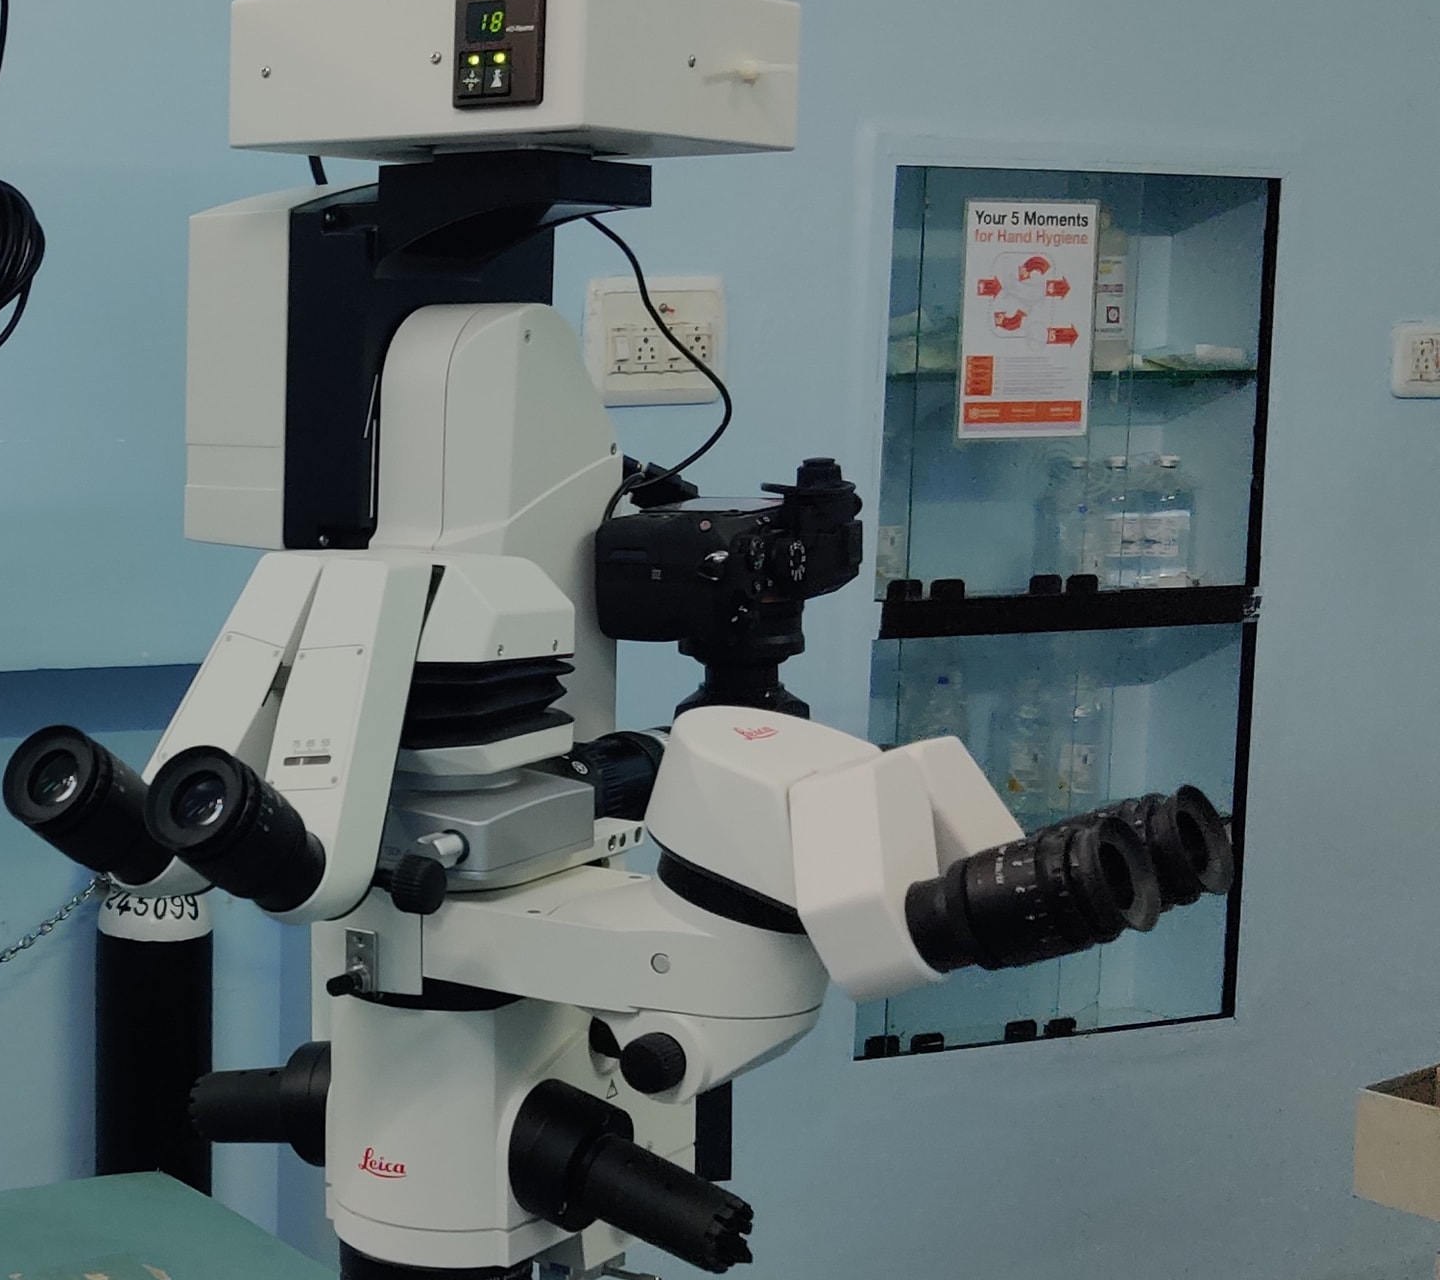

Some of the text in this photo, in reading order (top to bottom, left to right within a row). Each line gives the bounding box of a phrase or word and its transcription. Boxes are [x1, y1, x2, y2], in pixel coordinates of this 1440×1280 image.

[480, 11, 505, 33] 18
[975, 209, 1089, 228] Your 5 Moments
[975, 228, 1089, 246] for Hand Hygiene
[733, 725, 779, 741] Leica
[358, 1147, 407, 1180] Leica
